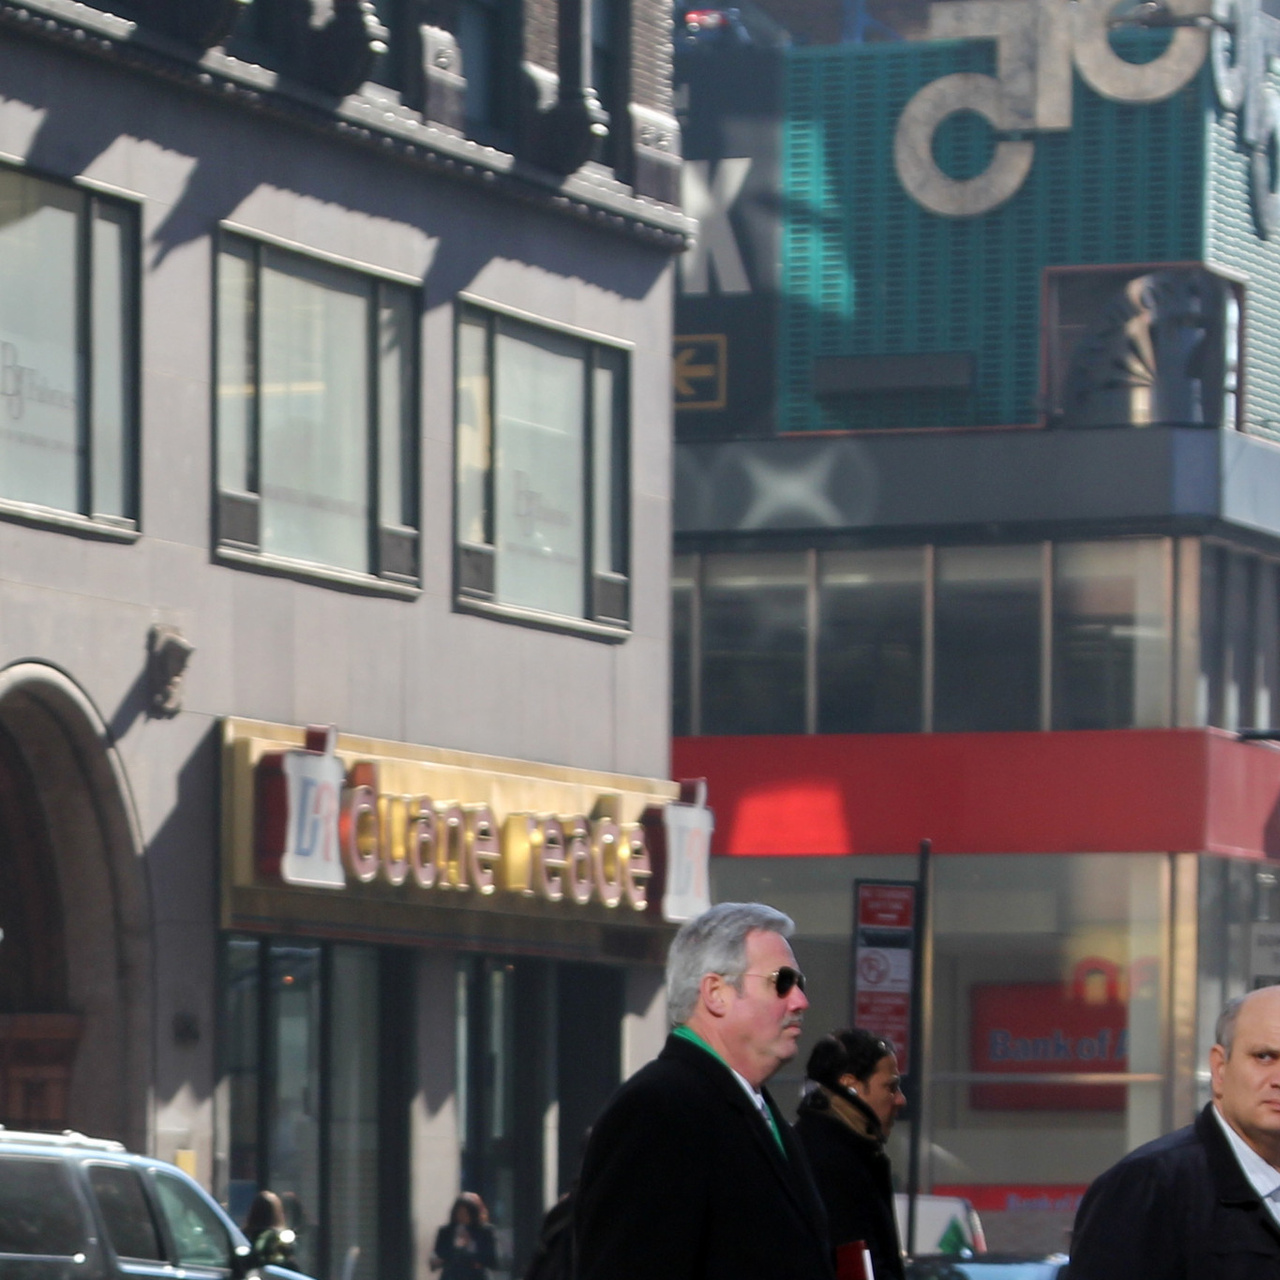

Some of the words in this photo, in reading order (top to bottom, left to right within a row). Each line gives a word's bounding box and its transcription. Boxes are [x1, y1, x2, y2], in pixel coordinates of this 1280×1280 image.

[339, 759, 500, 896] duane
[502, 794, 653, 911] reade
[988, 1029, 1070, 1062] Bank
[1076, 1027, 1114, 1060] of
